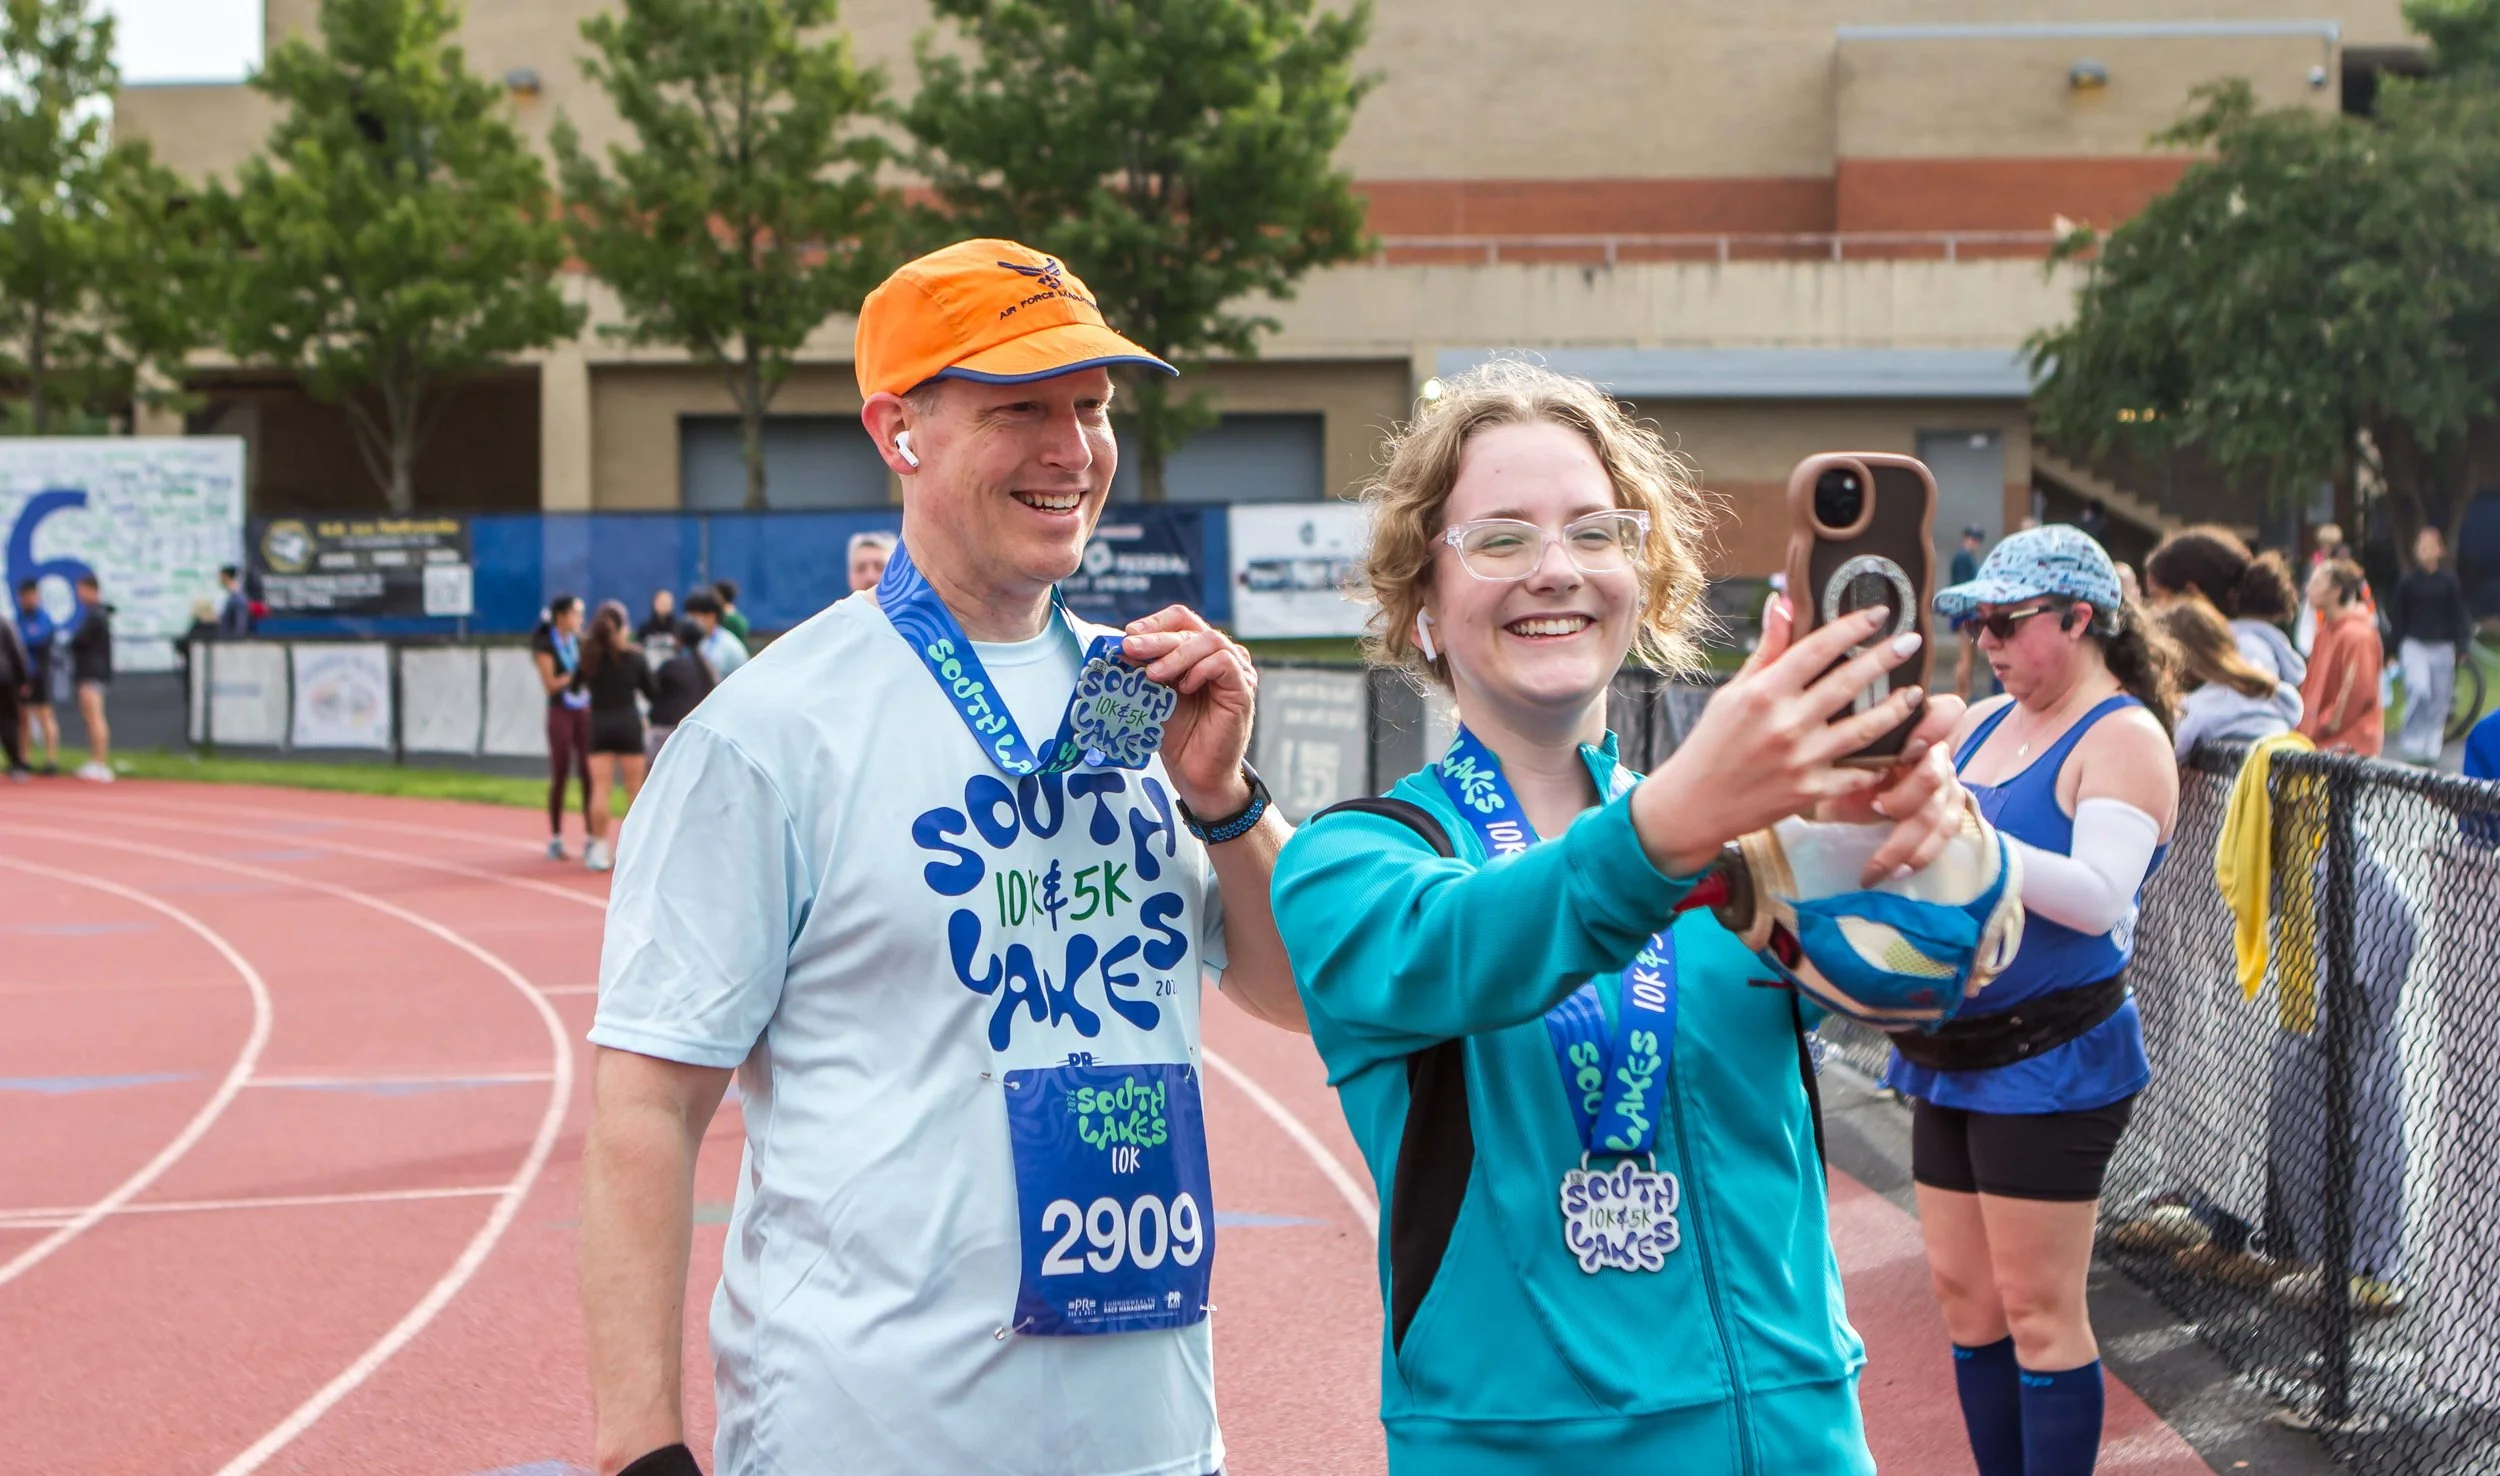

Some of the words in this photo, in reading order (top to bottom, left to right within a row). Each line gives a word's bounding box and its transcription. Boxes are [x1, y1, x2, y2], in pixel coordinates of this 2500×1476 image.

[1000, 305, 1017, 321] AIR
[1020, 291, 1056, 308] FORCE
[927, 638, 1008, 735] SOUTH
[1083, 669, 1174, 721] SOUTH
[1077, 701, 1161, 762] LAKES
[1442, 729, 1506, 814] LAKES
[911, 739, 1177, 897] SOUTH
[947, 891, 1189, 1052] LAKES
[1077, 1076, 1165, 1117] SOUTH
[1568, 1040, 1605, 1115] SOU
[1605, 1029, 1662, 1151] LAKES
[1079, 1110, 1168, 1151] LAKES
[1111, 1146, 1141, 1175] 10K
[1566, 1166, 1673, 1214] SOUTH
[1041, 1191, 1203, 1277] 2909
[1571, 1221, 1675, 1268] LAKES
